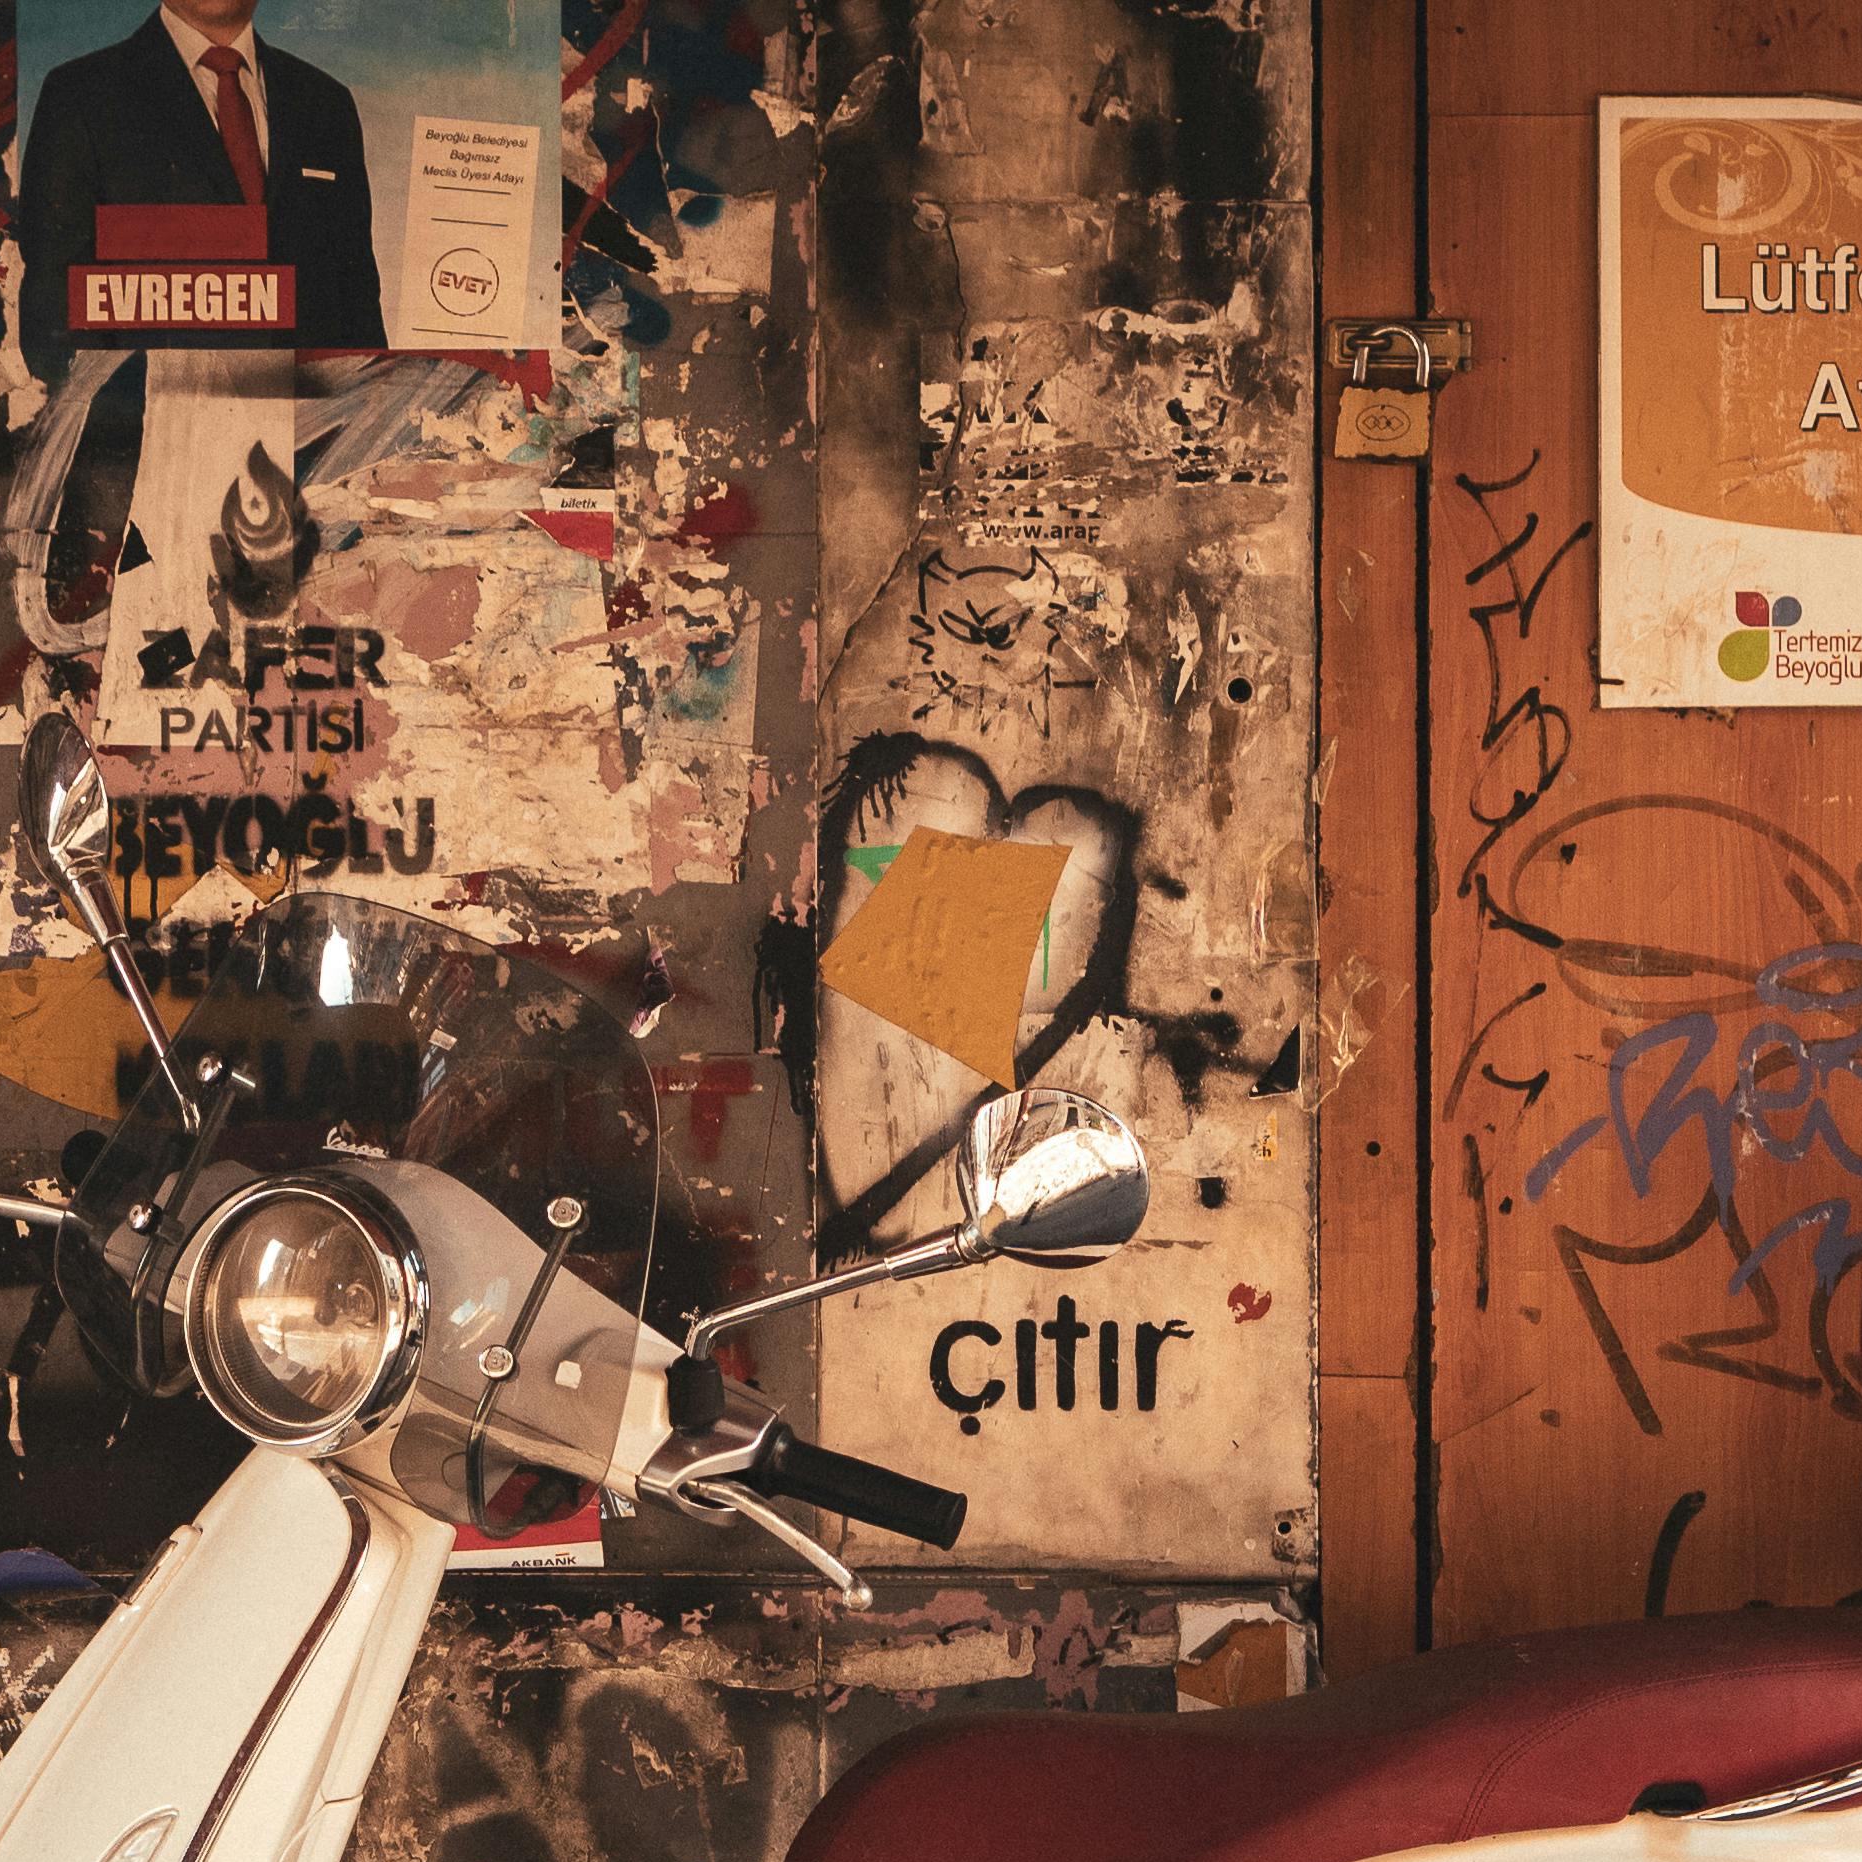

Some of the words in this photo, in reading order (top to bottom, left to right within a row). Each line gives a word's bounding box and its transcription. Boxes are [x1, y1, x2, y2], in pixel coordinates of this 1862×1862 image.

[425, 129, 469, 145] Beyoğlu
[472, 133, 528, 149] Belediyesi
[449, 149, 501, 164] Bağımsız
[422, 165, 457, 179] Meclis
[460, 166, 492, 182] Üyesi
[492, 171, 525, 186] Adayı
[437, 270, 493, 296] EVET
[84, 272, 280, 323] EVREGEN
[560, 496, 597, 509] biletix
[1773, 629, 1862, 653] Tertemiz
[1775, 654, 1862, 686] Beyoğlu
[160, 697, 365, 754] PARTİSİ
[109, 773, 435, 876] BEYOĞLU
[929, 1293, 1194, 1437] çıtır
[511, 1553, 577, 1567] AKBANK
